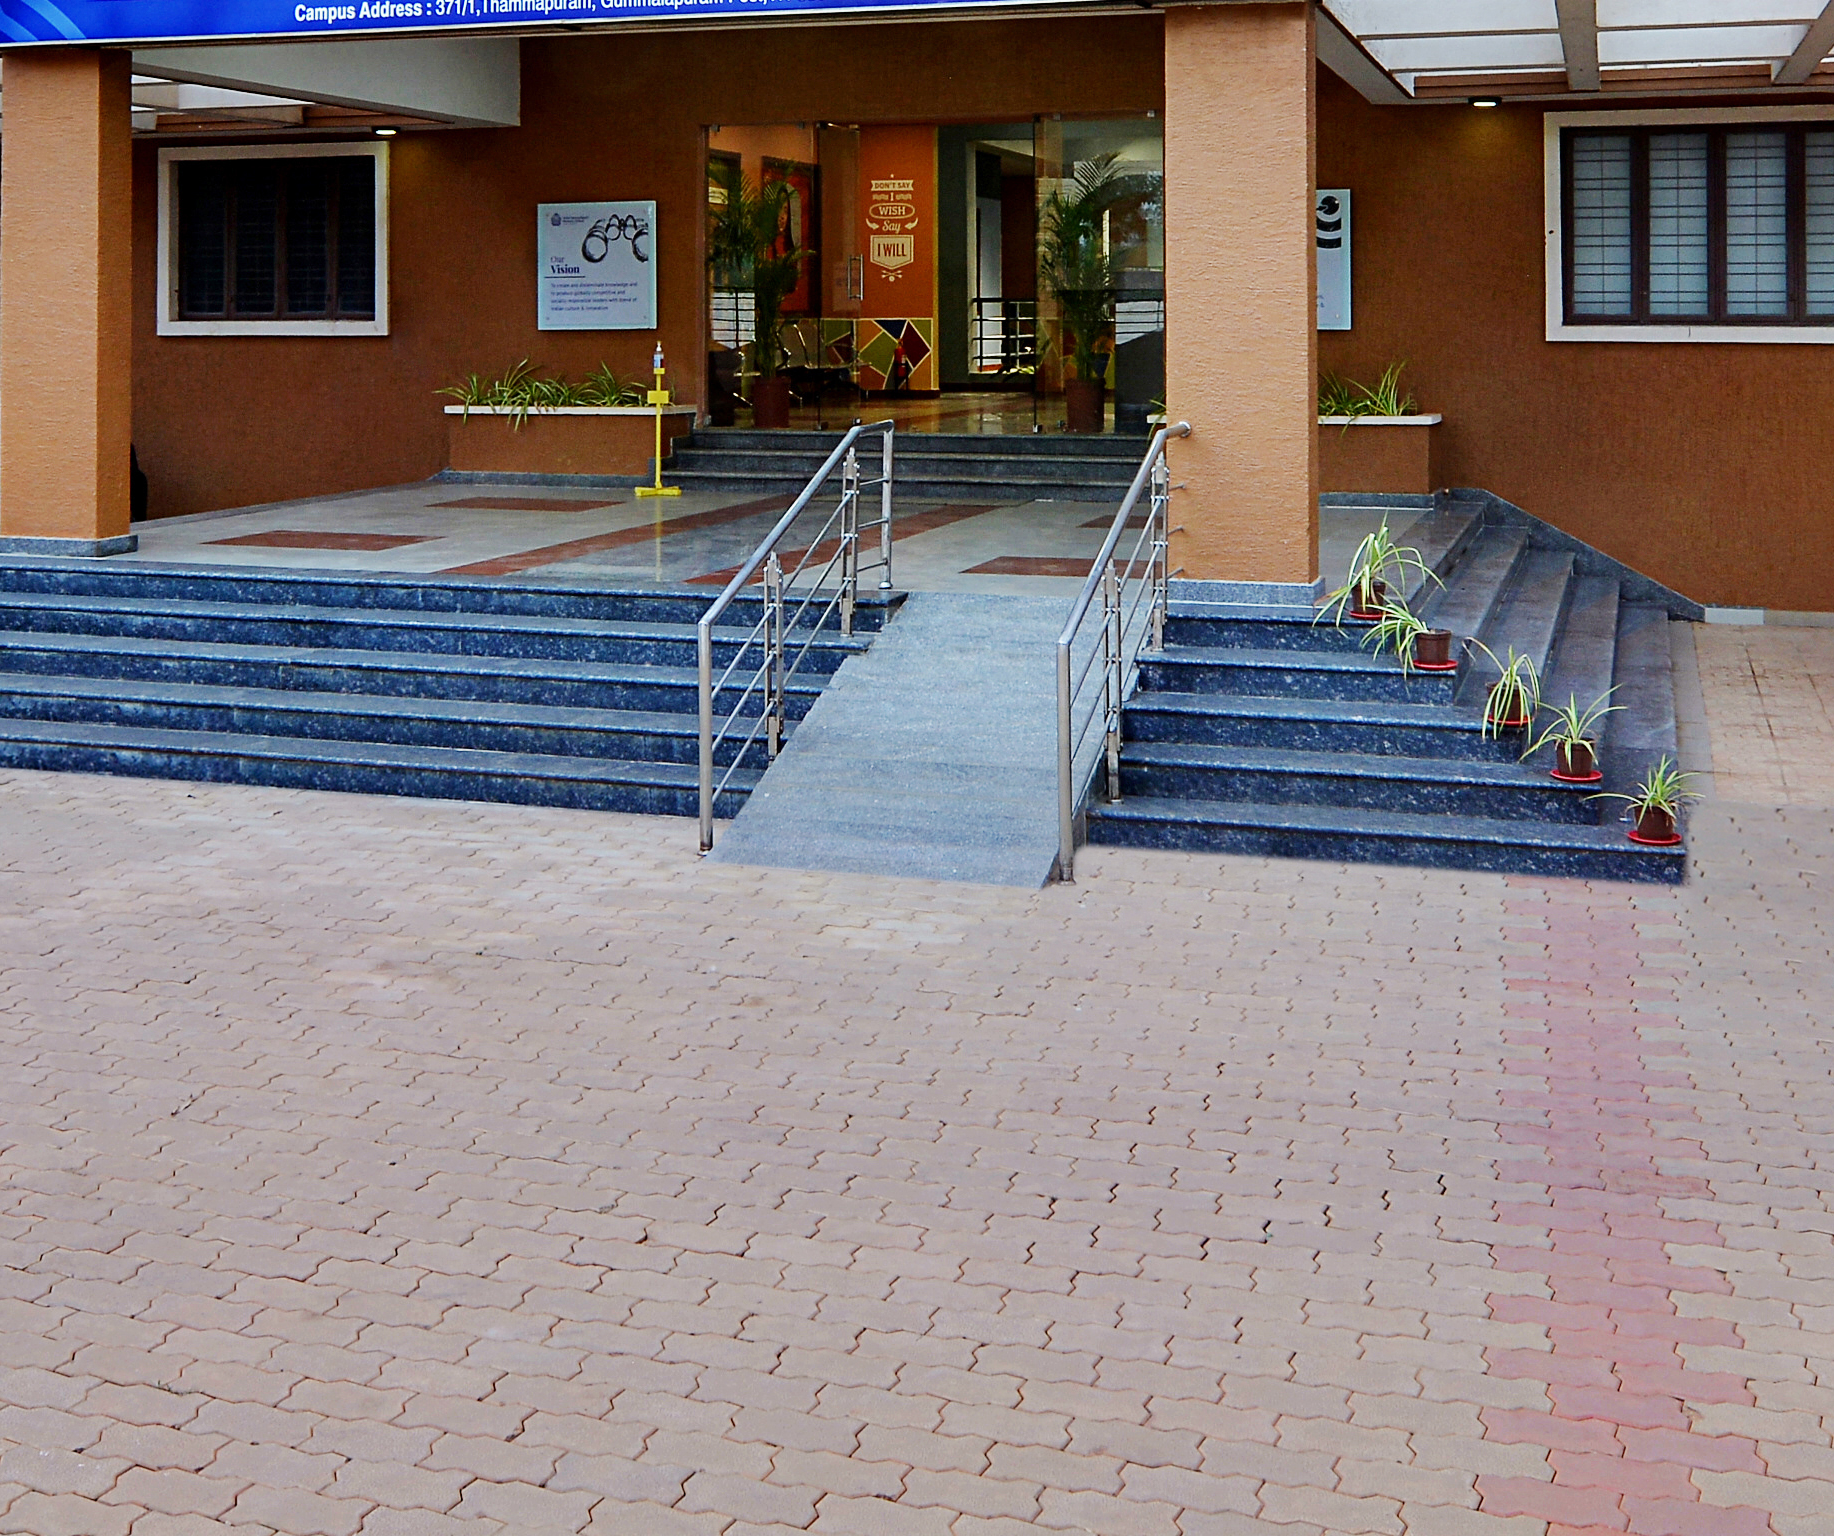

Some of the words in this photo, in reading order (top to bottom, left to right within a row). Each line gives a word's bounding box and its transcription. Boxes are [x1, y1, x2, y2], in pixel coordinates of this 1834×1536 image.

[294, 5, 356, 25] Campus
[358, 1, 423, 20] Address
[878, 206, 906, 216] WISH
[882, 219, 901, 234] Say
[877, 243, 881, 257] I
[883, 243, 907, 257] WILL
[550, 264, 580, 274] Vision
